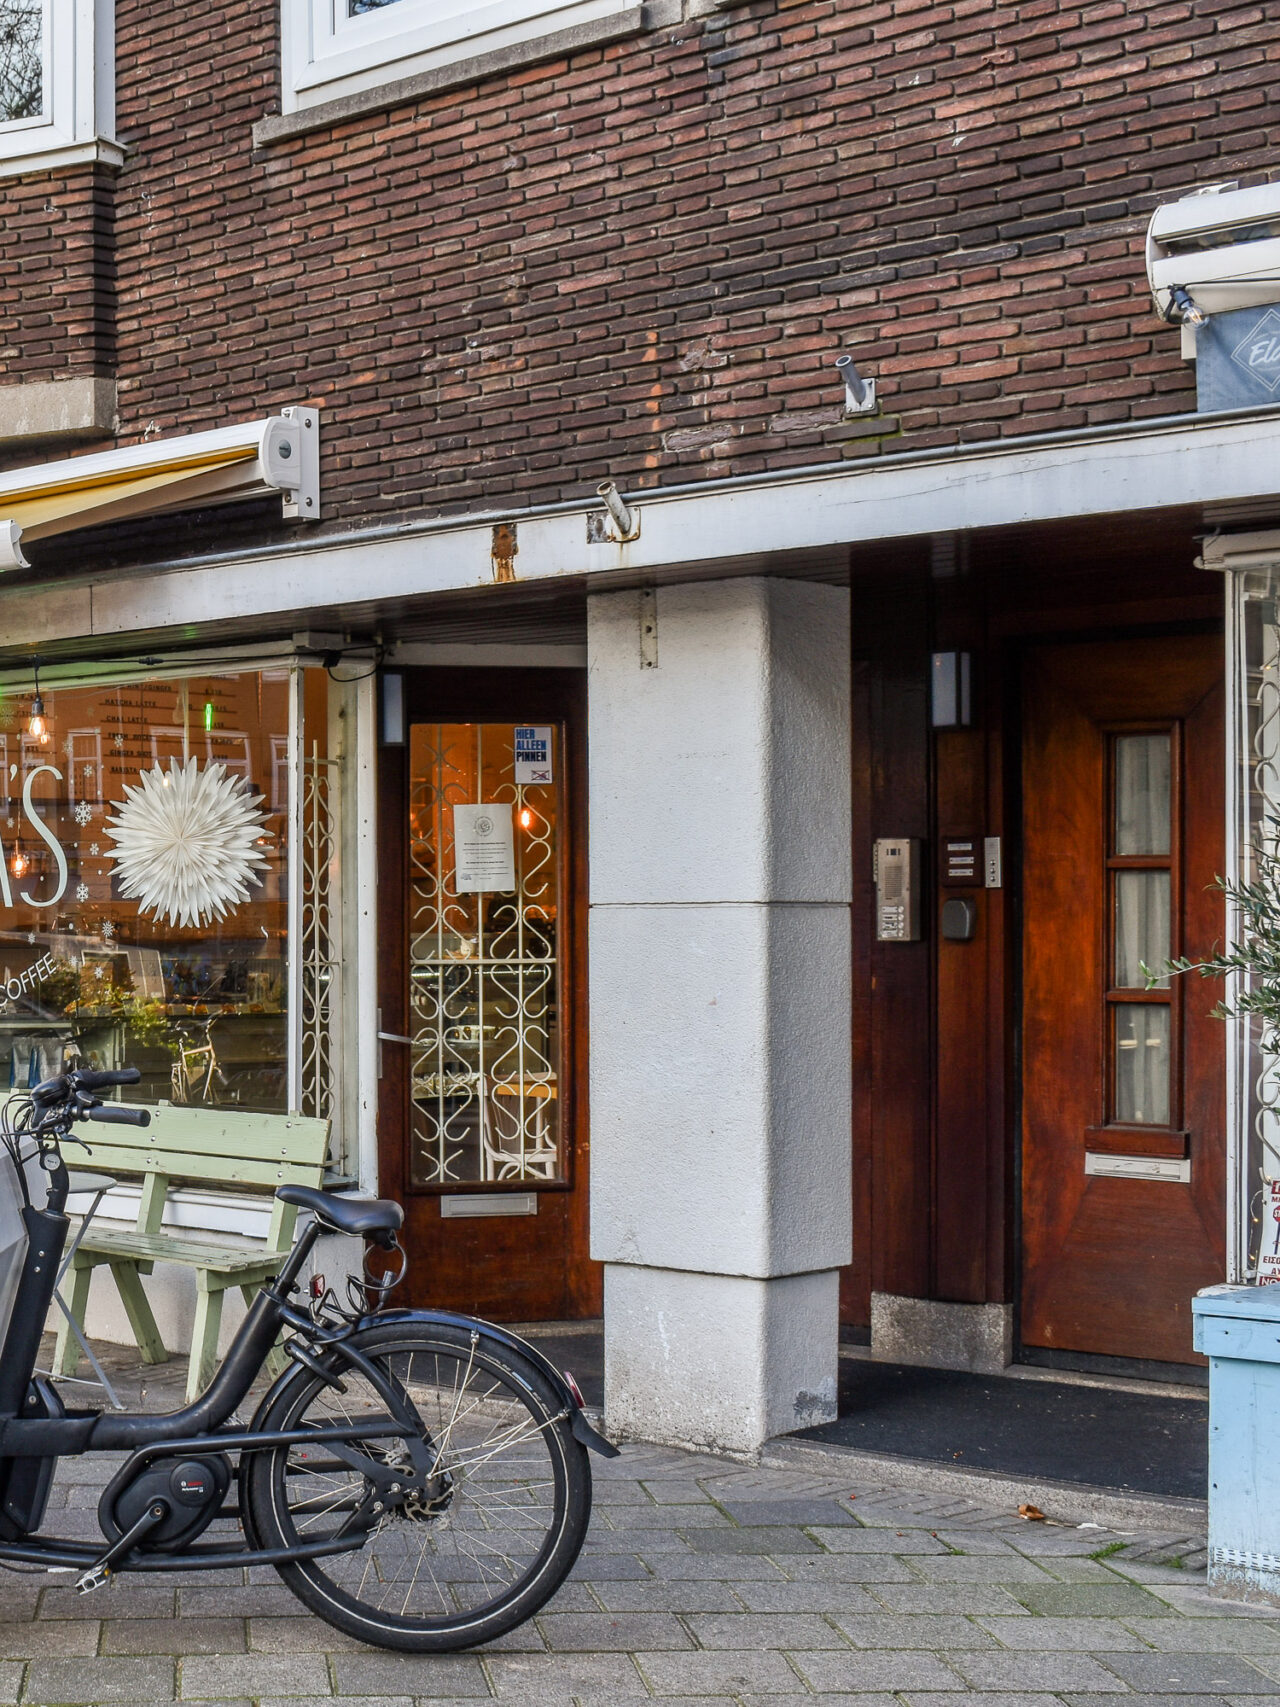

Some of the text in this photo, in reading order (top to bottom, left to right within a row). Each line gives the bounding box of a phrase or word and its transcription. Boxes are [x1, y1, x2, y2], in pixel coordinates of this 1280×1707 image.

[516, 728, 535, 739] HIER
[517, 740, 547, 750] ALLEEN
[517, 751, 547, 762] PINNEN
